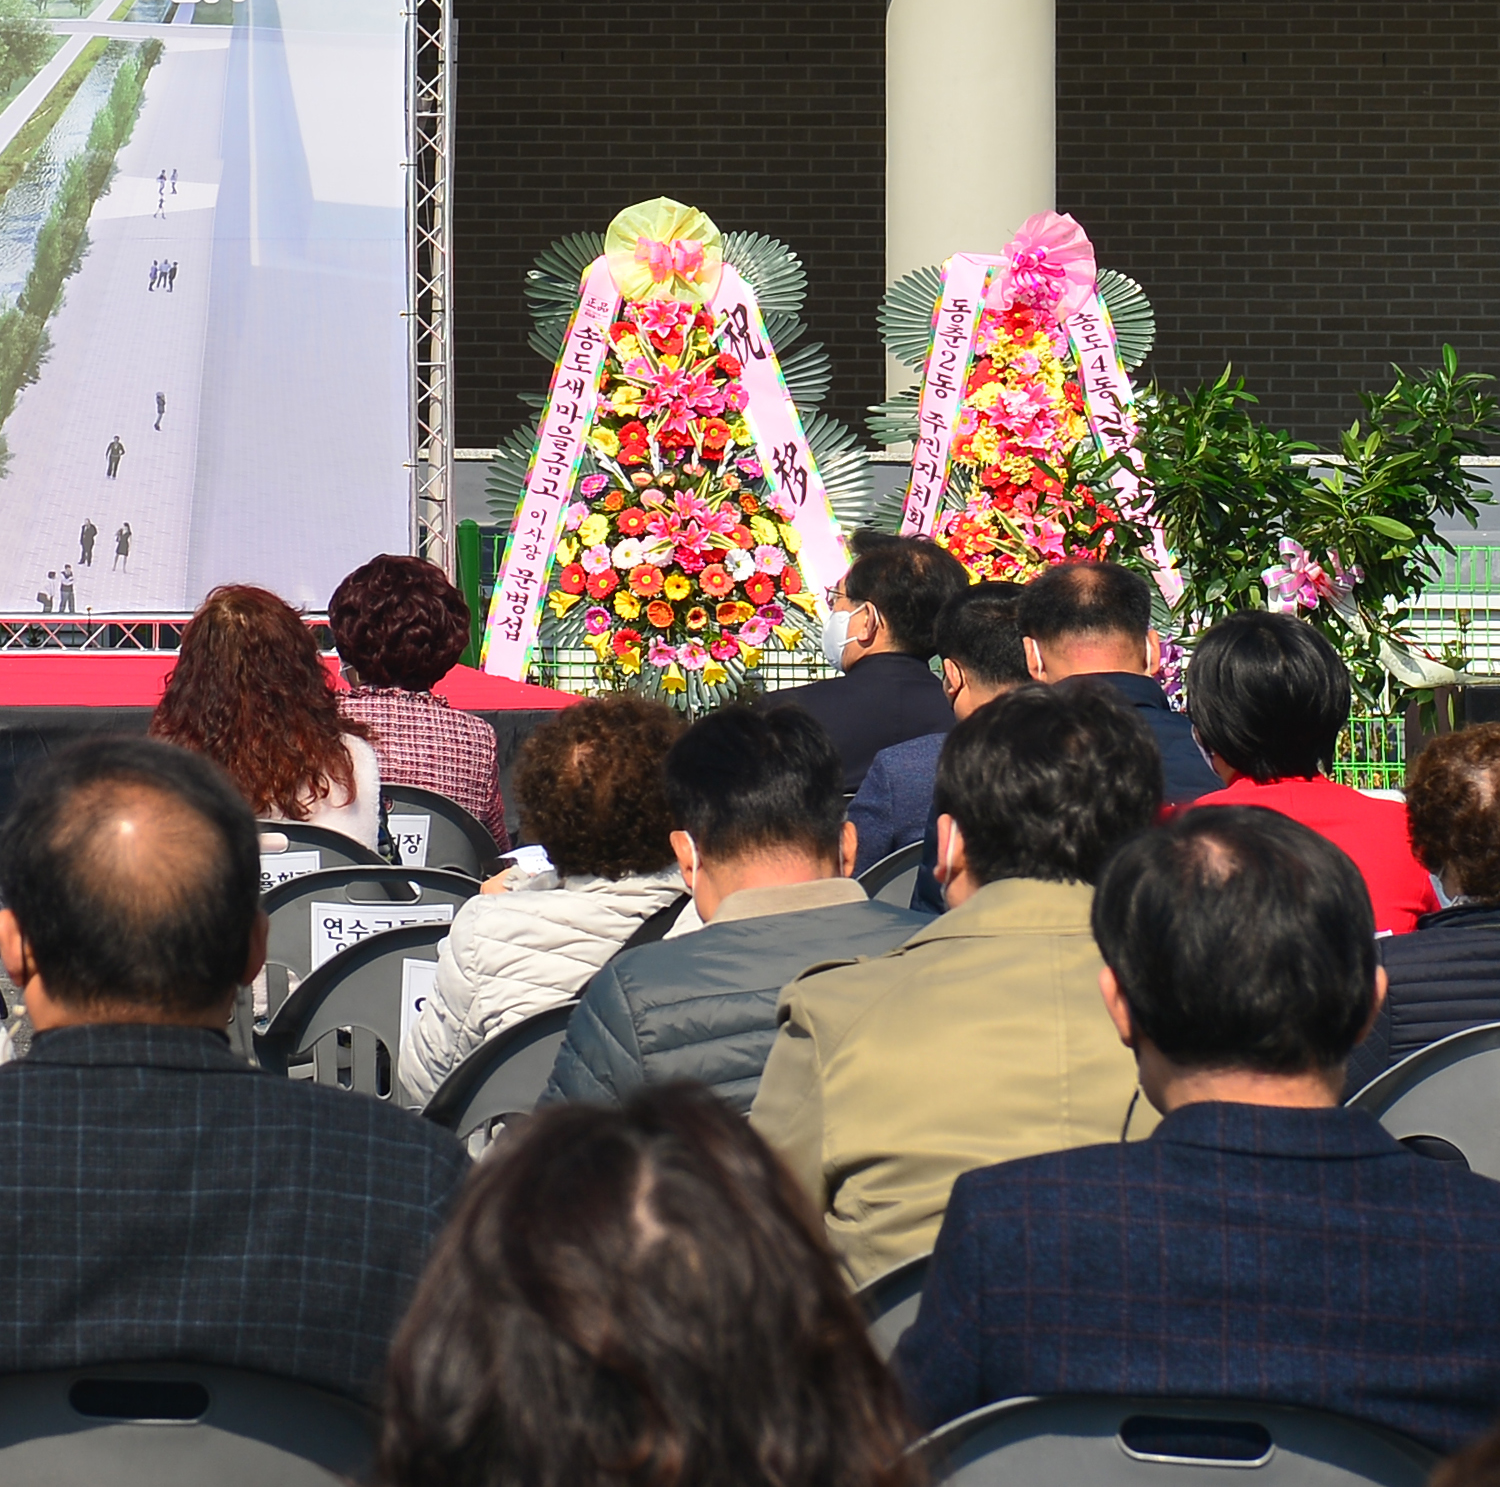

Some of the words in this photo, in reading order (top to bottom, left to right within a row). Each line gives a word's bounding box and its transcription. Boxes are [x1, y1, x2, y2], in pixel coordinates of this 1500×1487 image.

[721, 303, 766, 368] 祝
[928, 298, 971, 399] 동춘2동
[1070, 313, 1117, 399] 송도4동
[532, 326, 602, 500] 송도새마을금고
[907, 411, 948, 533] 주민자치회
[520, 509, 547, 560] 이사장
[497, 567, 538, 642] 문병섭
